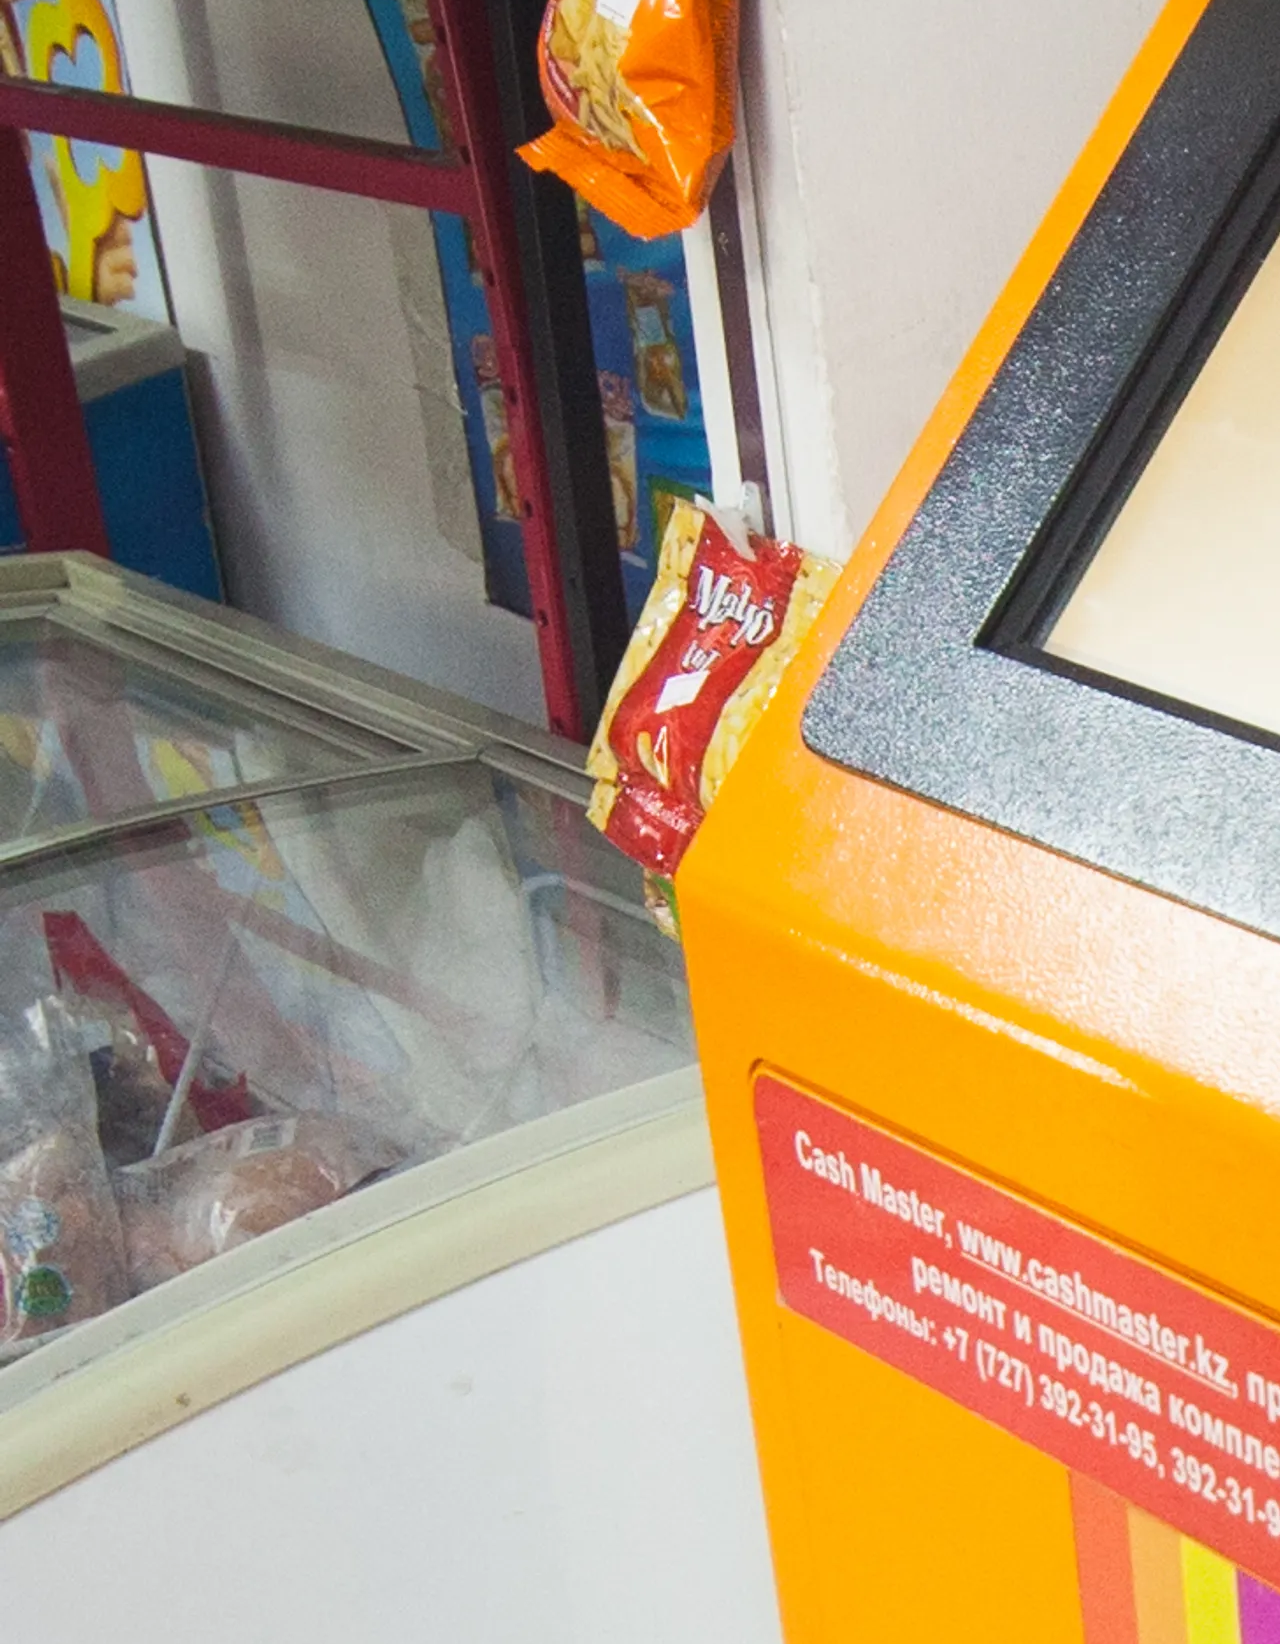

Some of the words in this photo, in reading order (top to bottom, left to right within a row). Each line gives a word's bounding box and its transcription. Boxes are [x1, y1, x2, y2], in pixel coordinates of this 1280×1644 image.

[793, 1129, 857, 1195] Cash
[858, 1161, 954, 1249] Master,
[956, 1219, 1239, 1400] www.cashmaster.kz,
[809, 1247, 939, 1346] Телефоны:
[942, 1325, 970, 1362] +7
[975, 1338, 1036, 1407] (727)
[1038, 1373, 1167, 1480] 392-31-95,
[911, 1255, 1008, 1331] ремонт
[1012, 1310, 1033, 1346] и
[1038, 1322, 1163, 1416] продажа
